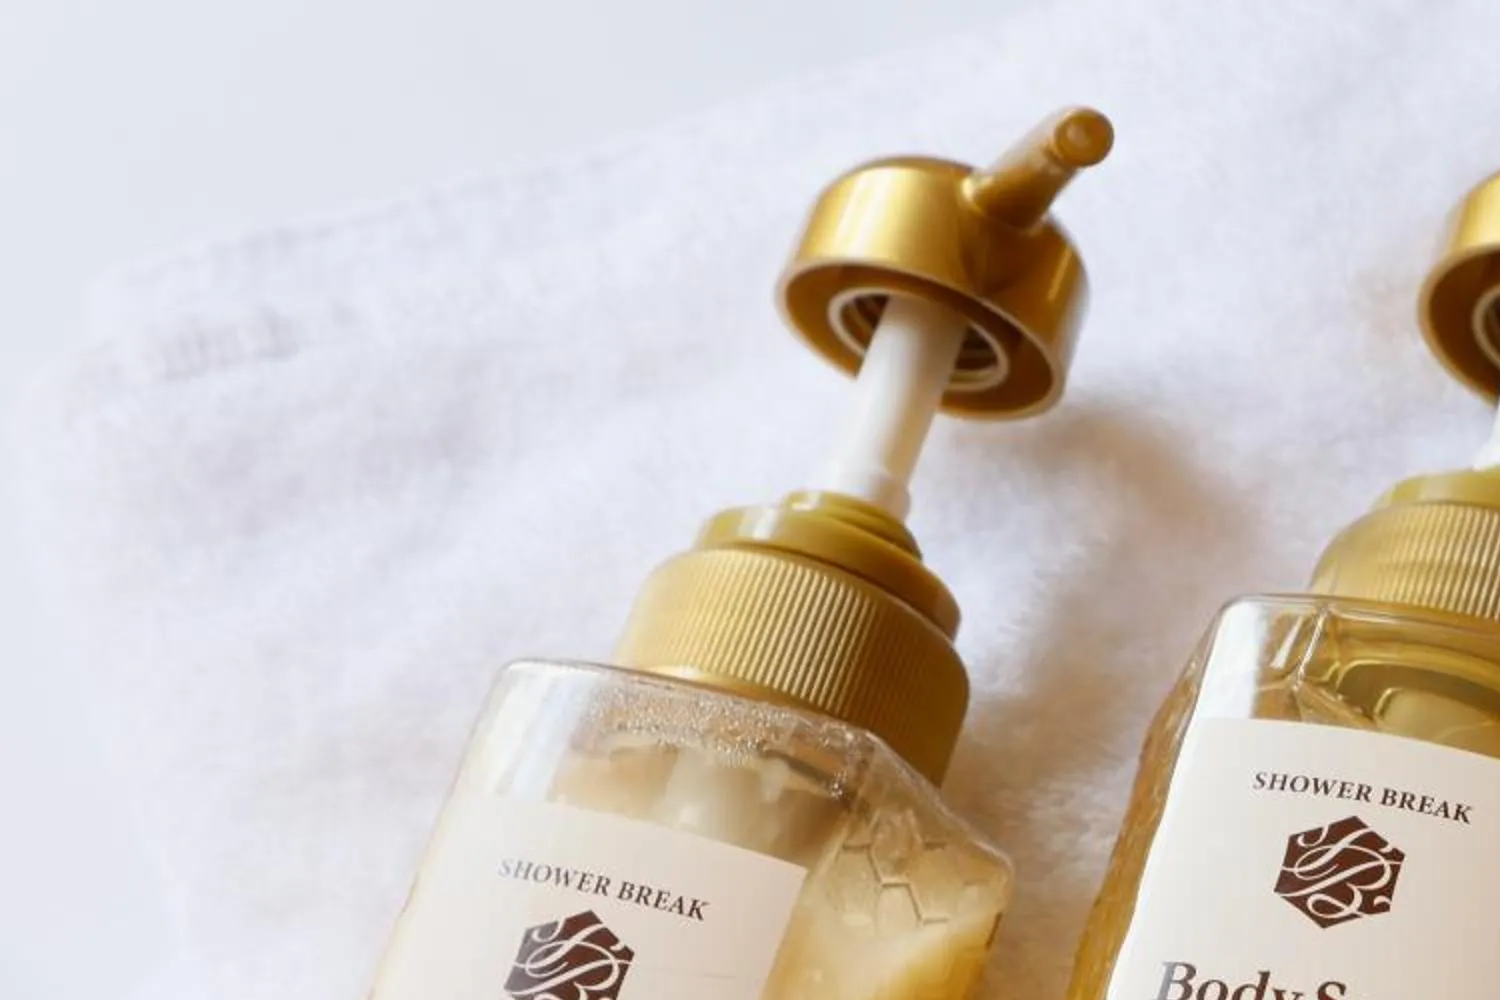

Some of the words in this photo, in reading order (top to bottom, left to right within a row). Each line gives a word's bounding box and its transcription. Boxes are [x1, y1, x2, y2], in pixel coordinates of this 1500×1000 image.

[1253, 771, 1373, 803] SHOWER
[1380, 788, 1473, 825] BREAK
[497, 857, 610, 897] SHOWER
[617, 880, 710, 921] BREAK
